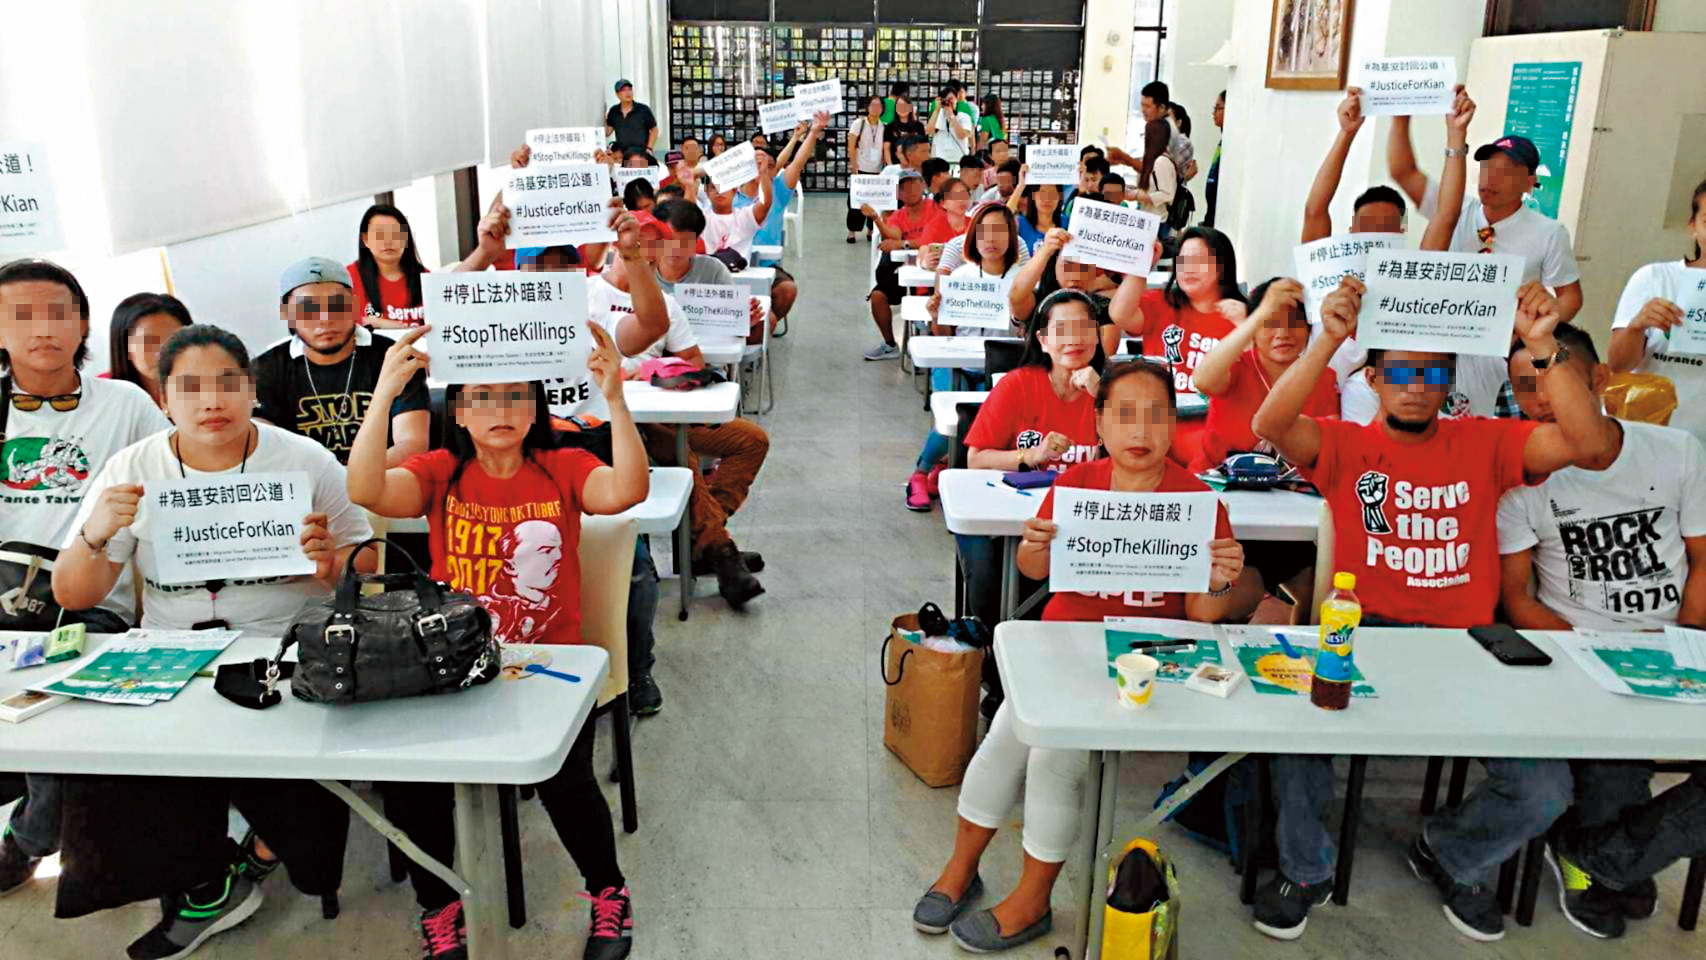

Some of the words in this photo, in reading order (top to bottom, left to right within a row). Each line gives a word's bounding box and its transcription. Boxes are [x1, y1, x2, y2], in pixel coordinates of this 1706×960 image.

[1370, 78, 1445, 91] #JusticeForKian
[533, 150, 591, 161] #StopTheKillings
[509, 172, 600, 191] #為基安討回公道！
[0, 194, 39, 212] Kian
[516, 201, 601, 218] #JusticeForKian
[1078, 227, 1145, 252] #JusticeForKian
[1377, 259, 1508, 284] #為基安討回公道！
[443, 281, 563, 305] #停止法外暗殺！
[945, 297, 1004, 312] #StopTheKillings
[682, 304, 744, 318] #StopTheKillings
[1379, 296, 1498, 318] #JusticeForKian
[441, 321, 576, 347] #StopTheKillings
[46, 495, 85, 504] Taiw
[159, 482, 295, 509] #為基安討回公道！
[1394, 480, 1470, 510] Serve
[1073, 500, 1193, 522] #停止法外暗殺！
[173, 519, 295, 543] #JusticeForKian
[447, 514, 502, 556] 1917
[1395, 512, 1459, 541] the
[1560, 511, 1663, 555] ROCK
[1066, 536, 1198, 561] #StopTheKillings
[1366, 534, 1470, 577] People
[1589, 543, 1666, 581] ROLL
[1406, 572, 1471, 588] Association
[1609, 584, 1681, 613] 1979
